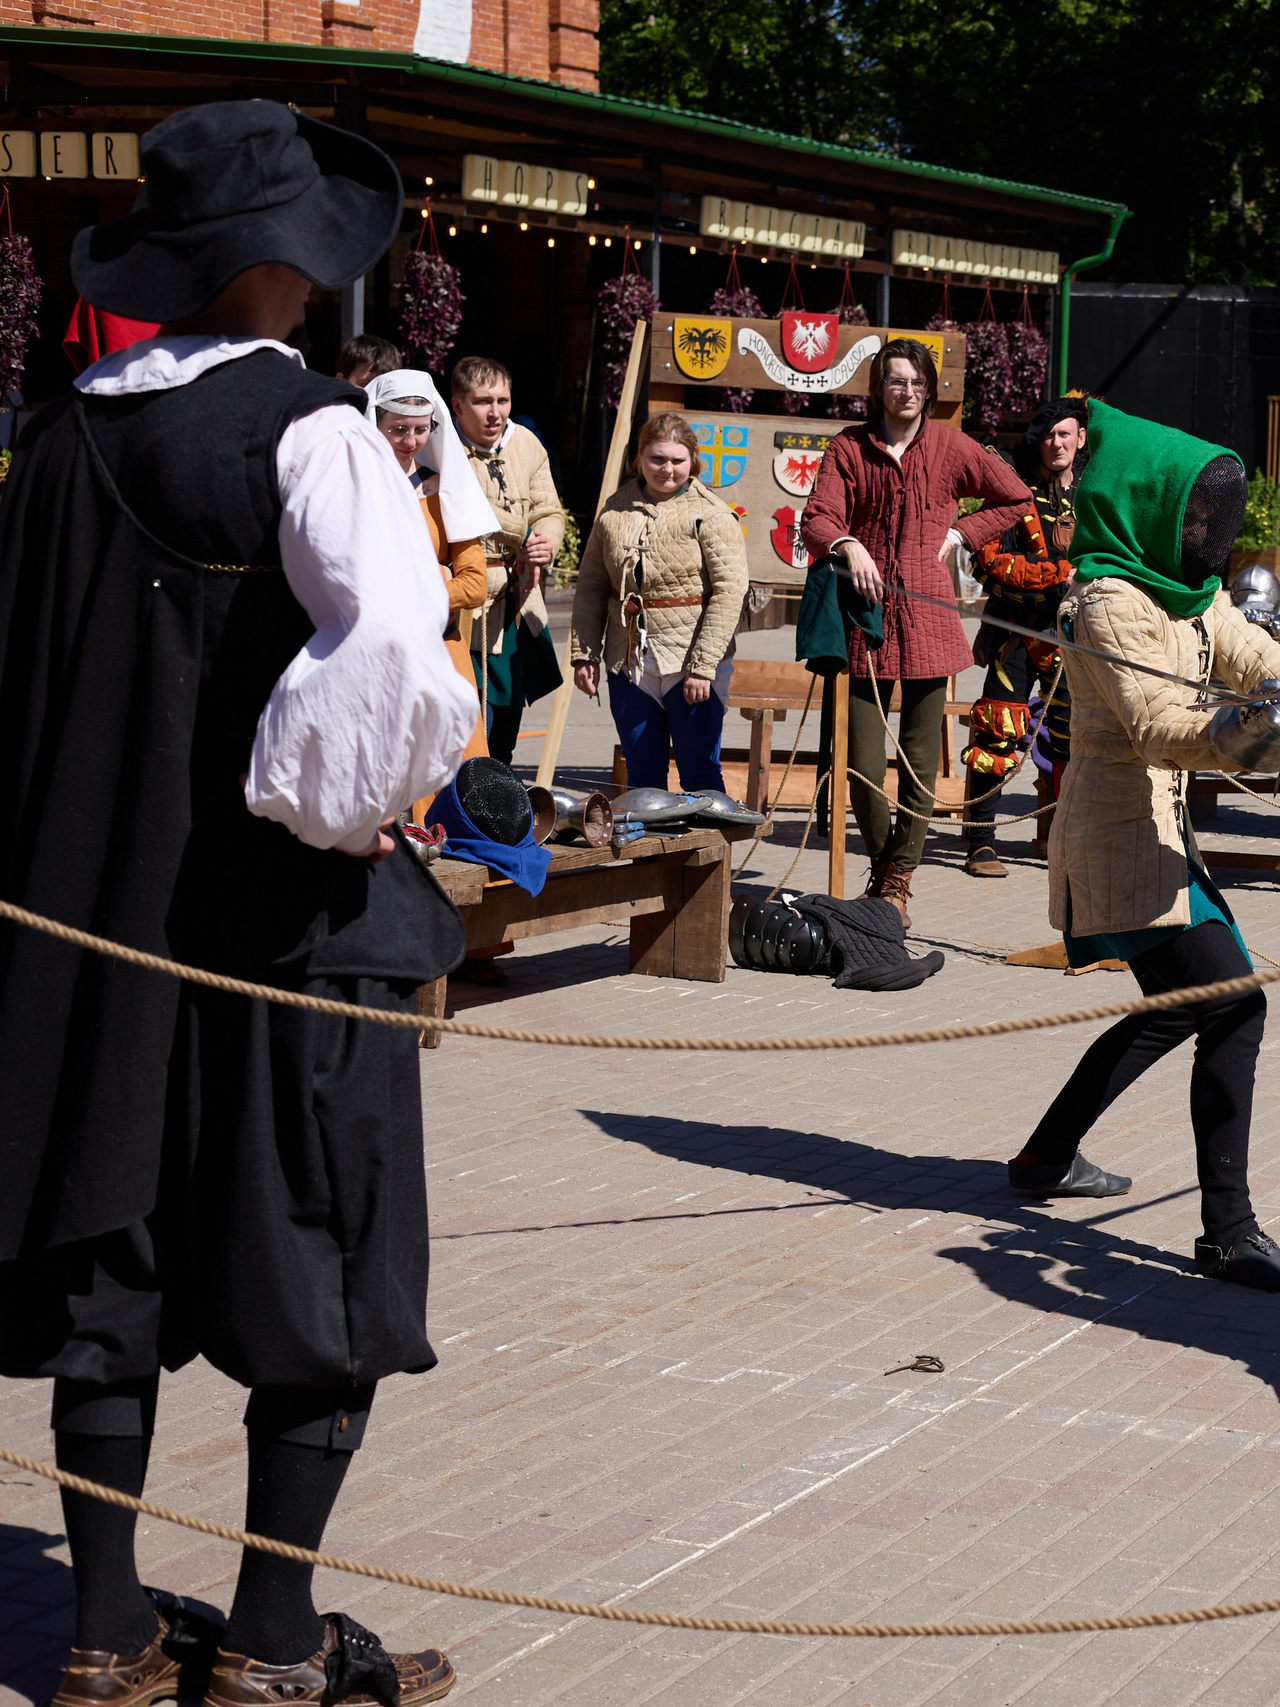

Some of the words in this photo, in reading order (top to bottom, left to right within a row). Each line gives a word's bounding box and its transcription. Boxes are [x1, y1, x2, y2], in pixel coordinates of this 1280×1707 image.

[484, 160, 583, 212] HOPS
[719, 200, 864, 255] BELGIAN
[749, 334, 785, 381] HONORIS
[834, 344, 866, 384] CAUSA
